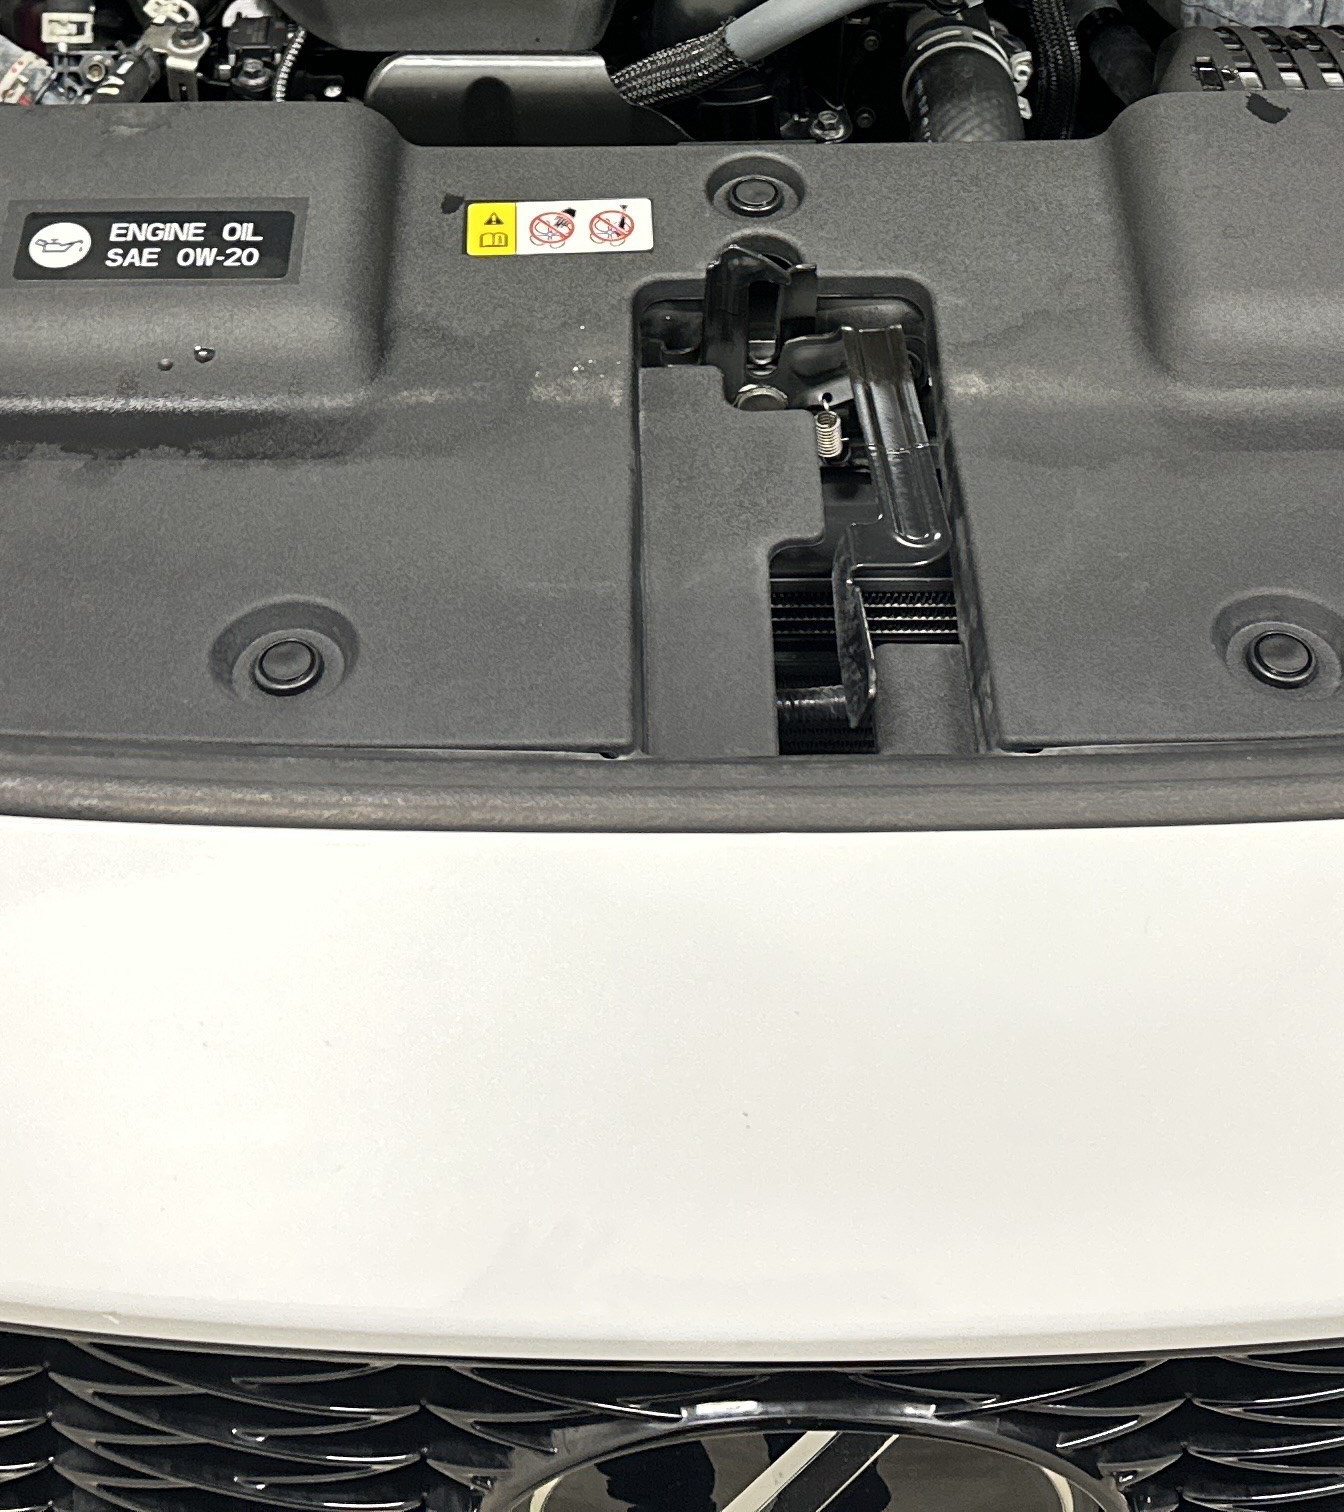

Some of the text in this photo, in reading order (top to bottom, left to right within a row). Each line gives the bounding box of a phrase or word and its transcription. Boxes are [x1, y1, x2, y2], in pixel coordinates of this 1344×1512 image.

[108, 222, 264, 242] ENGINE OIL
[104, 247, 260, 267] SAE 0W-20
